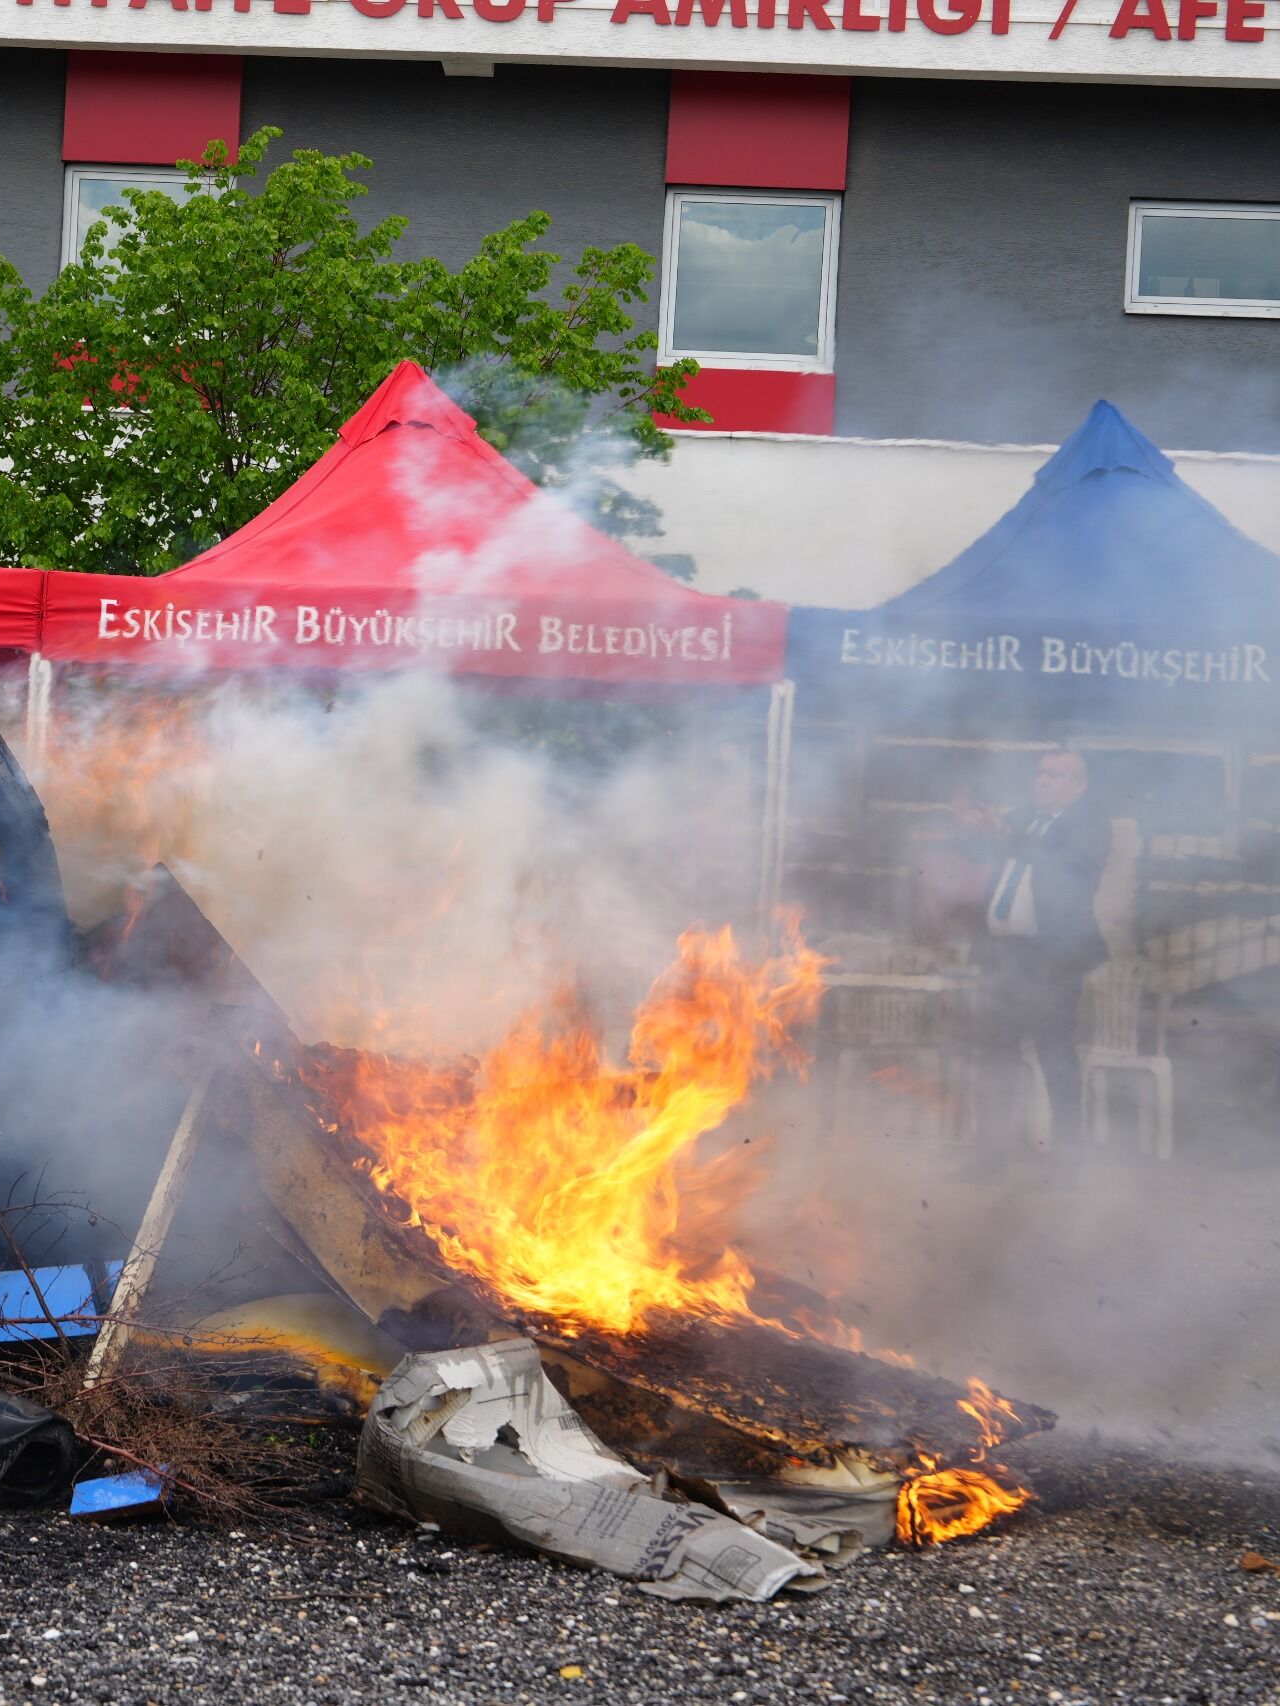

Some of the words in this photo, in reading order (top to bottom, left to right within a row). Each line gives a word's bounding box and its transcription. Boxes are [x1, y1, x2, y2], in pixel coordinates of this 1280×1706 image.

[98, 598, 279, 648] ESKİŞEHİR
[295, 604, 522, 653] BÜYÜKŞEHİR
[538, 612, 733, 661] BELEDİYESİ
[840, 628, 1024, 673] ESKİŞEHİR
[1040, 636, 1271, 686] BÜYÜKŞEHİR
